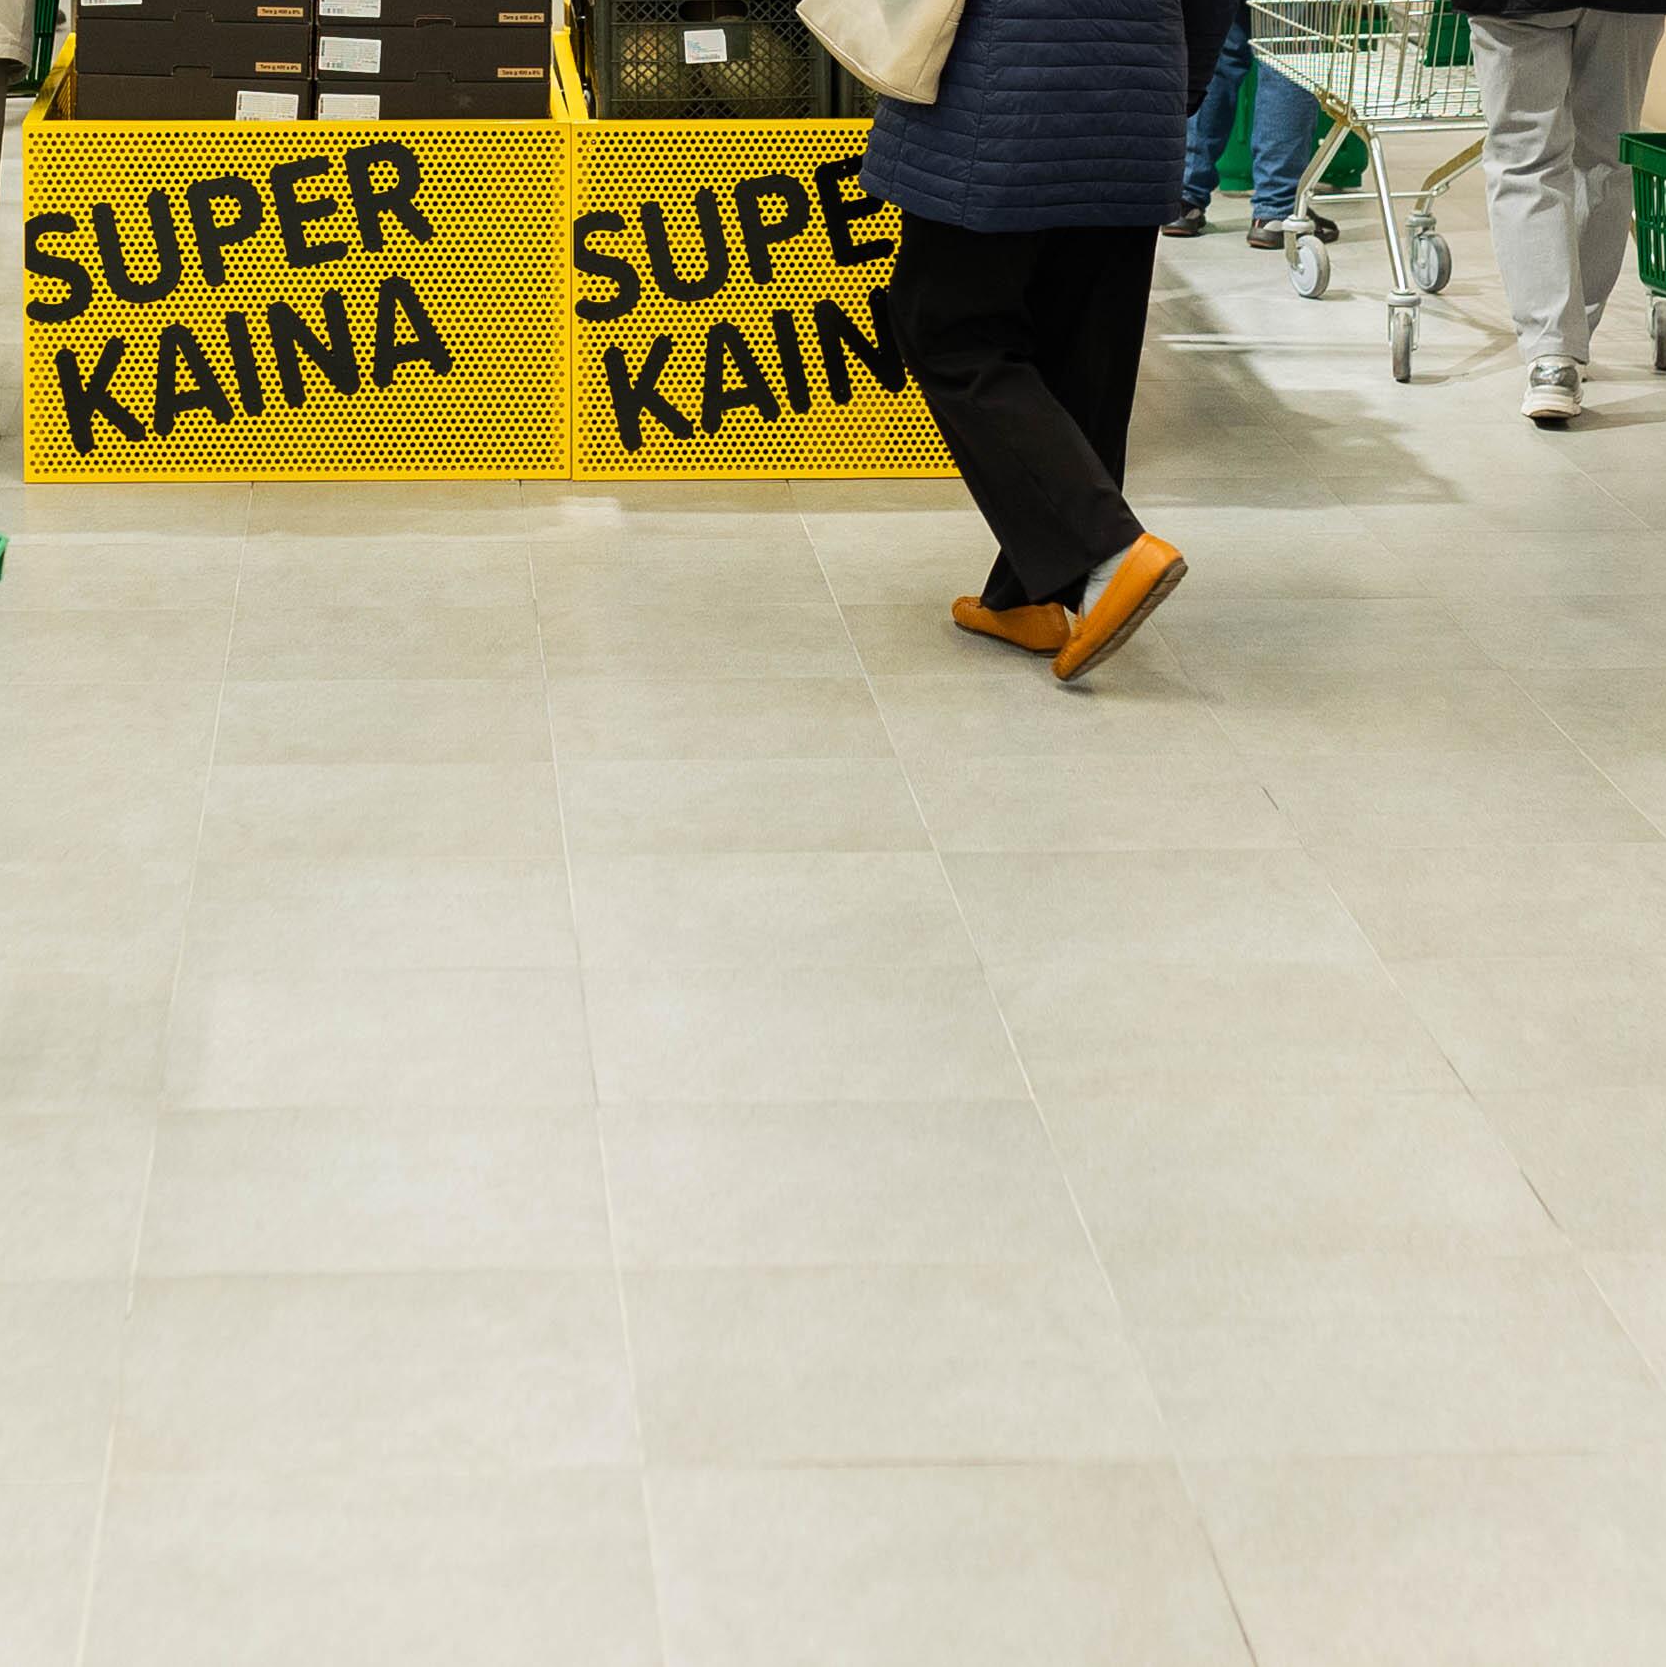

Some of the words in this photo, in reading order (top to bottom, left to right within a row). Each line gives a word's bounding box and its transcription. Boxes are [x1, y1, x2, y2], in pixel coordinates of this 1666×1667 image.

[23, 140, 436, 324] SUPER
[573, 152, 901, 322] SUPE
[53, 276, 454, 455] KAINA
[601, 286, 909, 453] KAIN
